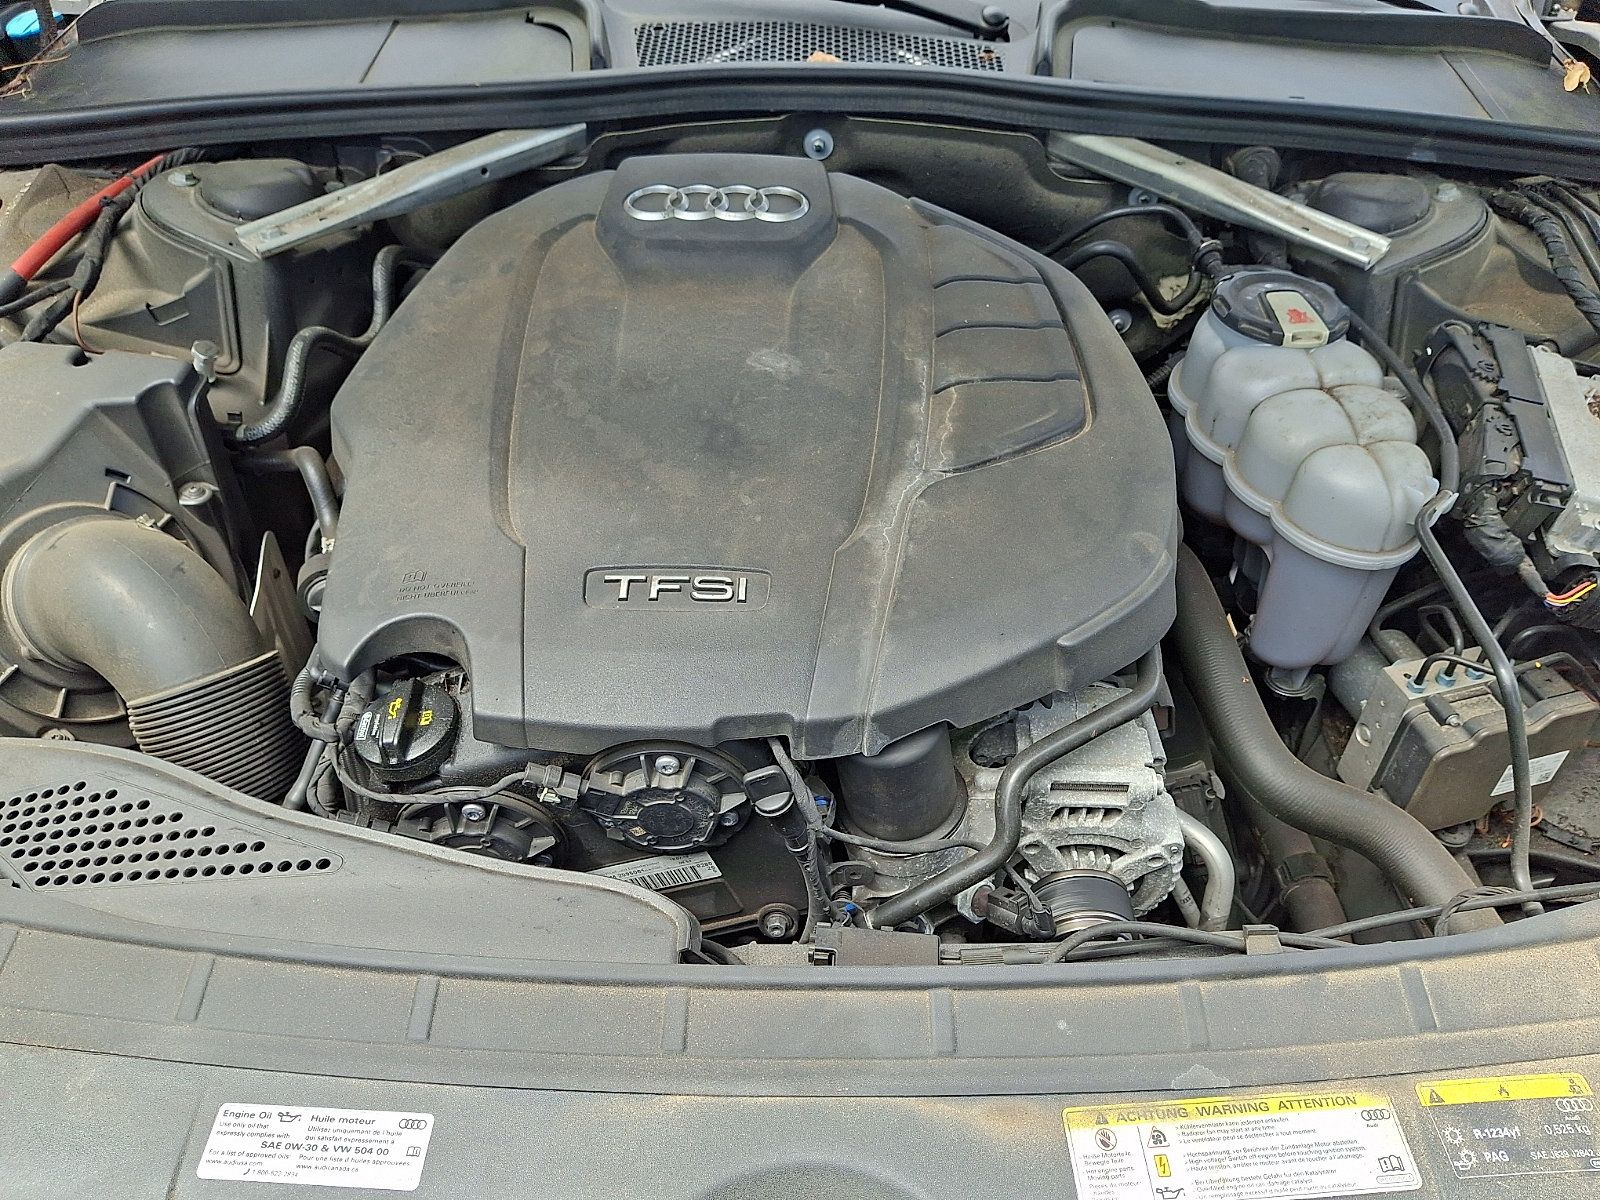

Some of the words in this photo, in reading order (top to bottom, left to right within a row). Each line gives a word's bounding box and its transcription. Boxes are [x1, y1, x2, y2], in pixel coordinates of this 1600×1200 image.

[603, 575, 748, 603] TFSI
[222, 1109, 256, 1120] Engine
[258, 1111, 273, 1120] Oil
[1116, 1107, 1190, 1123] ACHTUNG
[1195, 1101, 1270, 1117] WARNING
[1278, 1095, 1358, 1111] ATTENTION
[310, 1114, 336, 1123] Huile
[338, 1117, 376, 1125] moteur
[307, 1125, 331, 1133] Utilisez
[1472, 1125, 1521, 1140] R-1234yf
[1574, 1123, 1592, 1136] kg
[260, 1140, 282, 1150] SAE
[284, 1142, 318, 1152] 0W-30
[320, 1144, 330, 1152] &
[333, 1145, 352, 1153] VW
[354, 1147, 373, 1155] 504
[376, 1148, 390, 1156] 00
[1483, 1150, 1510, 1163] PAG
[1529, 1150, 1548, 1160] SAE
